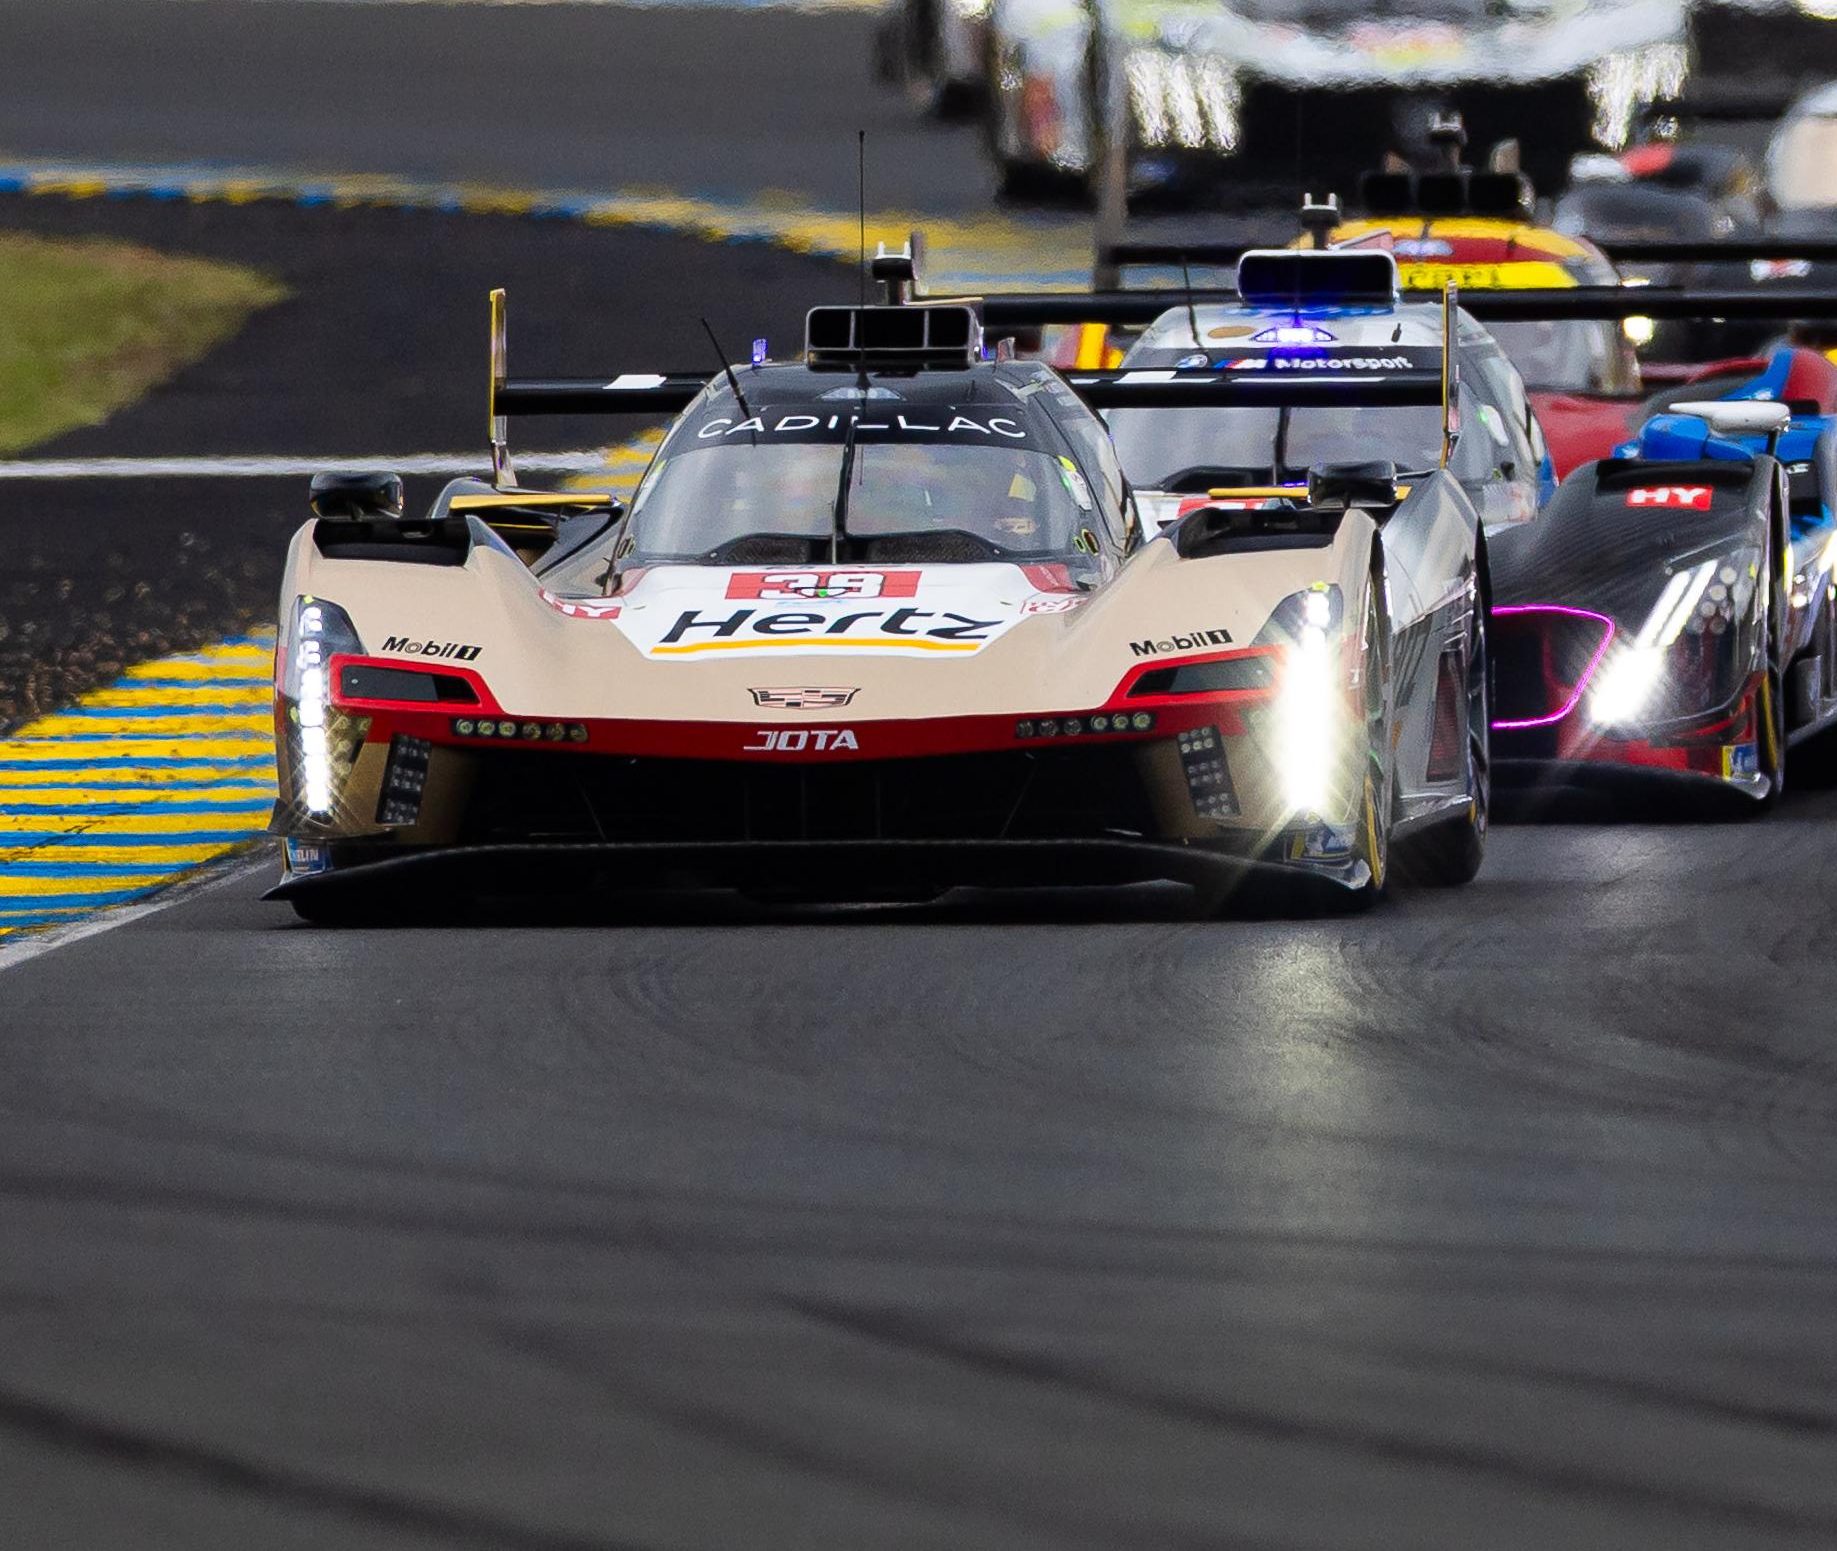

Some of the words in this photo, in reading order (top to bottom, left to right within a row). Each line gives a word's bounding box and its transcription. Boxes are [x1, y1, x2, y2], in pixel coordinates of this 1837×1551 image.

[1274, 356, 1413, 370] Motorsport
[697, 415, 1026, 439] CADILLAC
[1631, 487, 1707, 504] HY
[659, 607, 1004, 643] Hertz
[381, 636, 458, 658] Mobil
[1129, 632, 1208, 656] Mobil
[743, 729, 859, 751] JOTA
